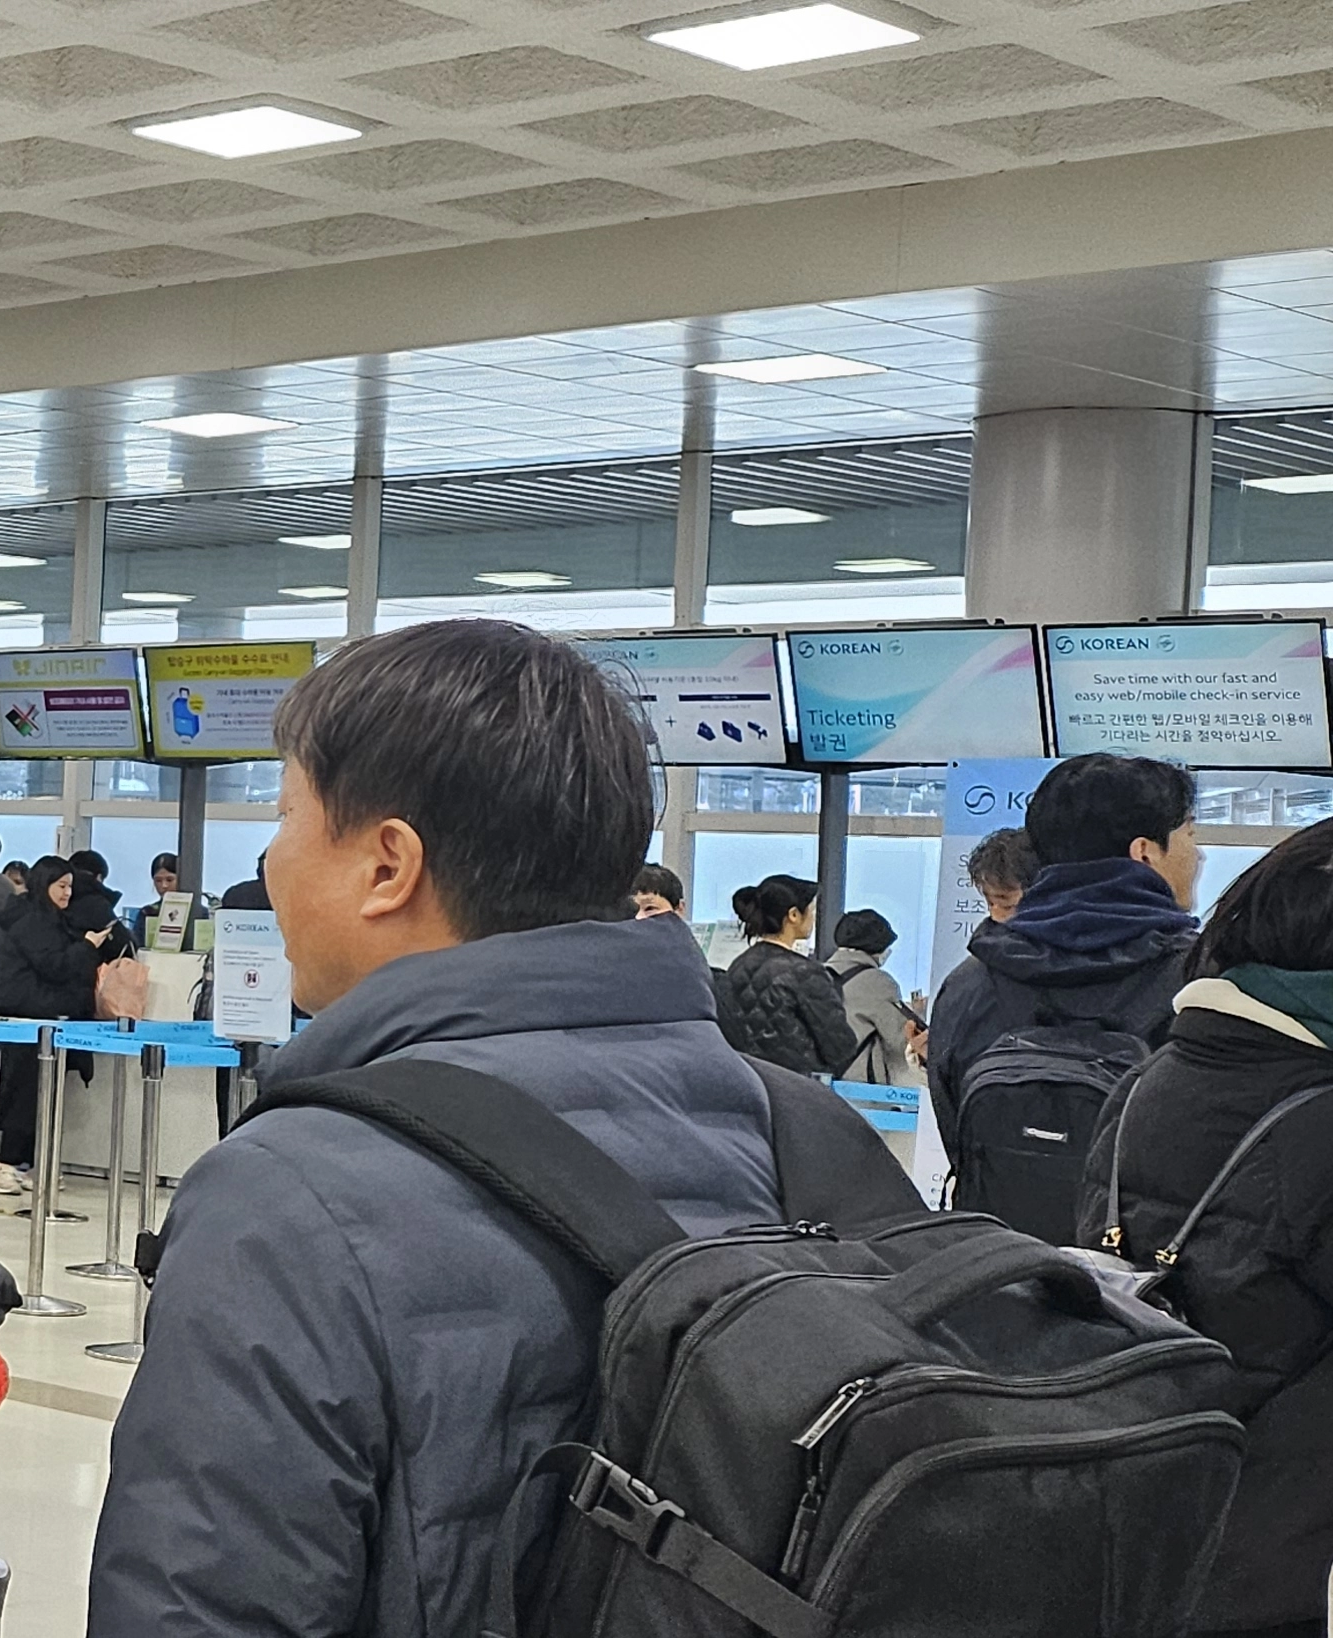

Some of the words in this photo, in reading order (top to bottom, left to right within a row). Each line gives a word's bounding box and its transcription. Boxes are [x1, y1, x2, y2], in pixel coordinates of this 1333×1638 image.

[820, 643, 882, 655] KOREAN
[1080, 638, 1150, 651] KOREAN
[1093, 674, 1126, 685] Save
[1128, 673, 1159, 684] time
[1162, 673, 1192, 684] with
[1195, 675, 1218, 684] our
[1222, 672, 1249, 684] fast
[1251, 672, 1278, 683] and
[1074, 691, 1104, 702] easy
[1107, 689, 1187, 702] web/mobile
[1190, 689, 1248, 701] check-in
[1251, 689, 1301, 701] service
[807, 710, 897, 729] Ticketing
[1068, 713, 1106, 727] 빠르고
[1109, 713, 1147, 727] 간편한
[1151, 713, 1211, 727] 웹/모바일
[1214, 712, 1268, 727] 체크인을
[1271, 712, 1313, 727] 이용해
[1100, 729, 1151, 743] 기다리는
[1155, 729, 1193, 743] 시간을
[809, 734, 847, 752] 발권
[235, 923, 270, 932] KOREAN
[65, 1037, 93, 1047] KOREAN
